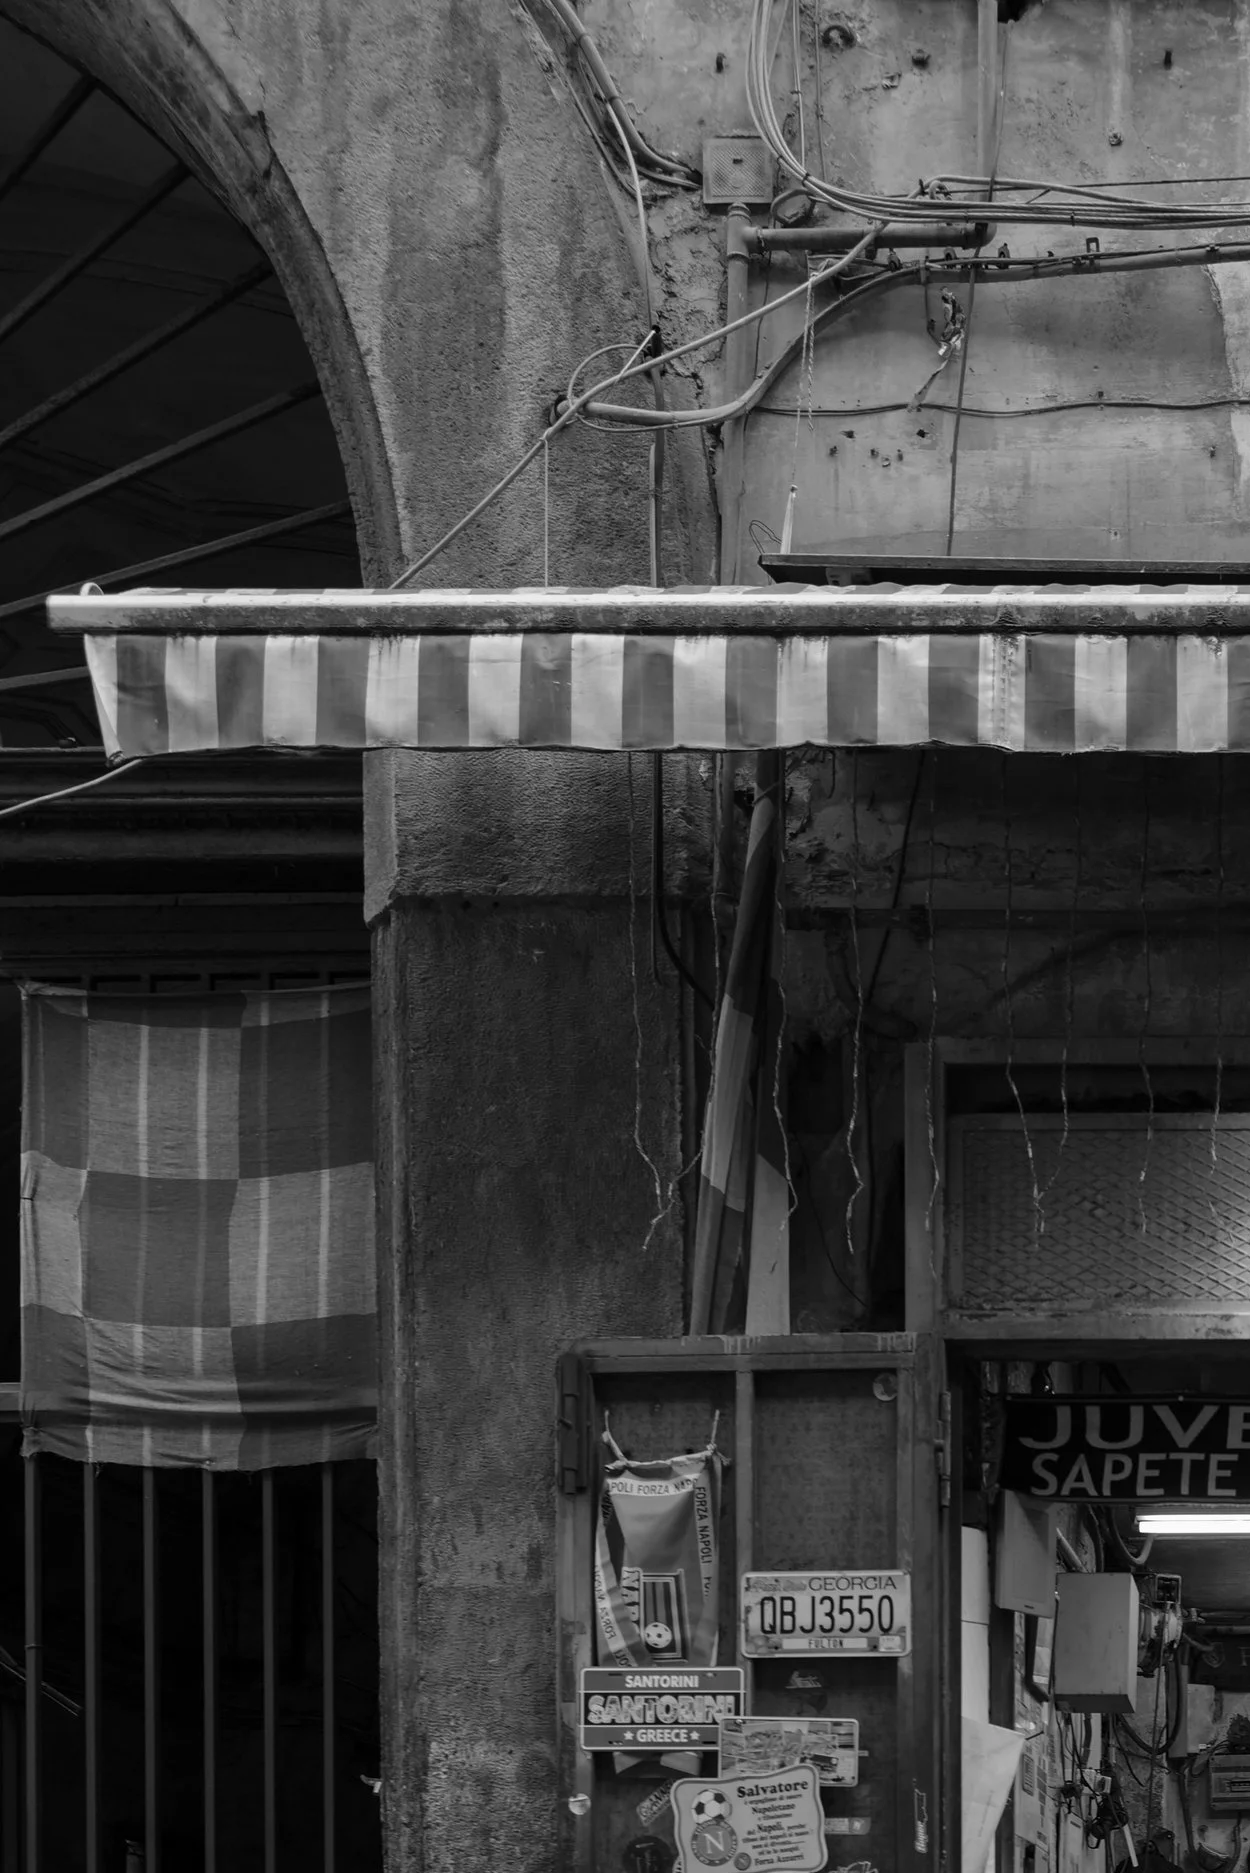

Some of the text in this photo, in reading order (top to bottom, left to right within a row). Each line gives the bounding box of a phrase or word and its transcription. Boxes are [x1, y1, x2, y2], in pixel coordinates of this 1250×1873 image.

[1030, 1451, 1237, 1497] SAPETE
[637, 1483, 670, 1495] FORZA
[695, 1486, 709, 1522] FORZA
[698, 1525, 713, 1565] NAPOLI
[808, 1576, 897, 1592] GEORGIA
[760, 1594, 894, 1635] QBJ3550
[808, 1639, 844, 1649] FULTON
[625, 1674, 699, 1688] SANTORINI
[587, 1694, 736, 1725] SANTORINI
[636, 1730, 689, 1743] GREECE
[737, 1780, 809, 1799] Salvatore
